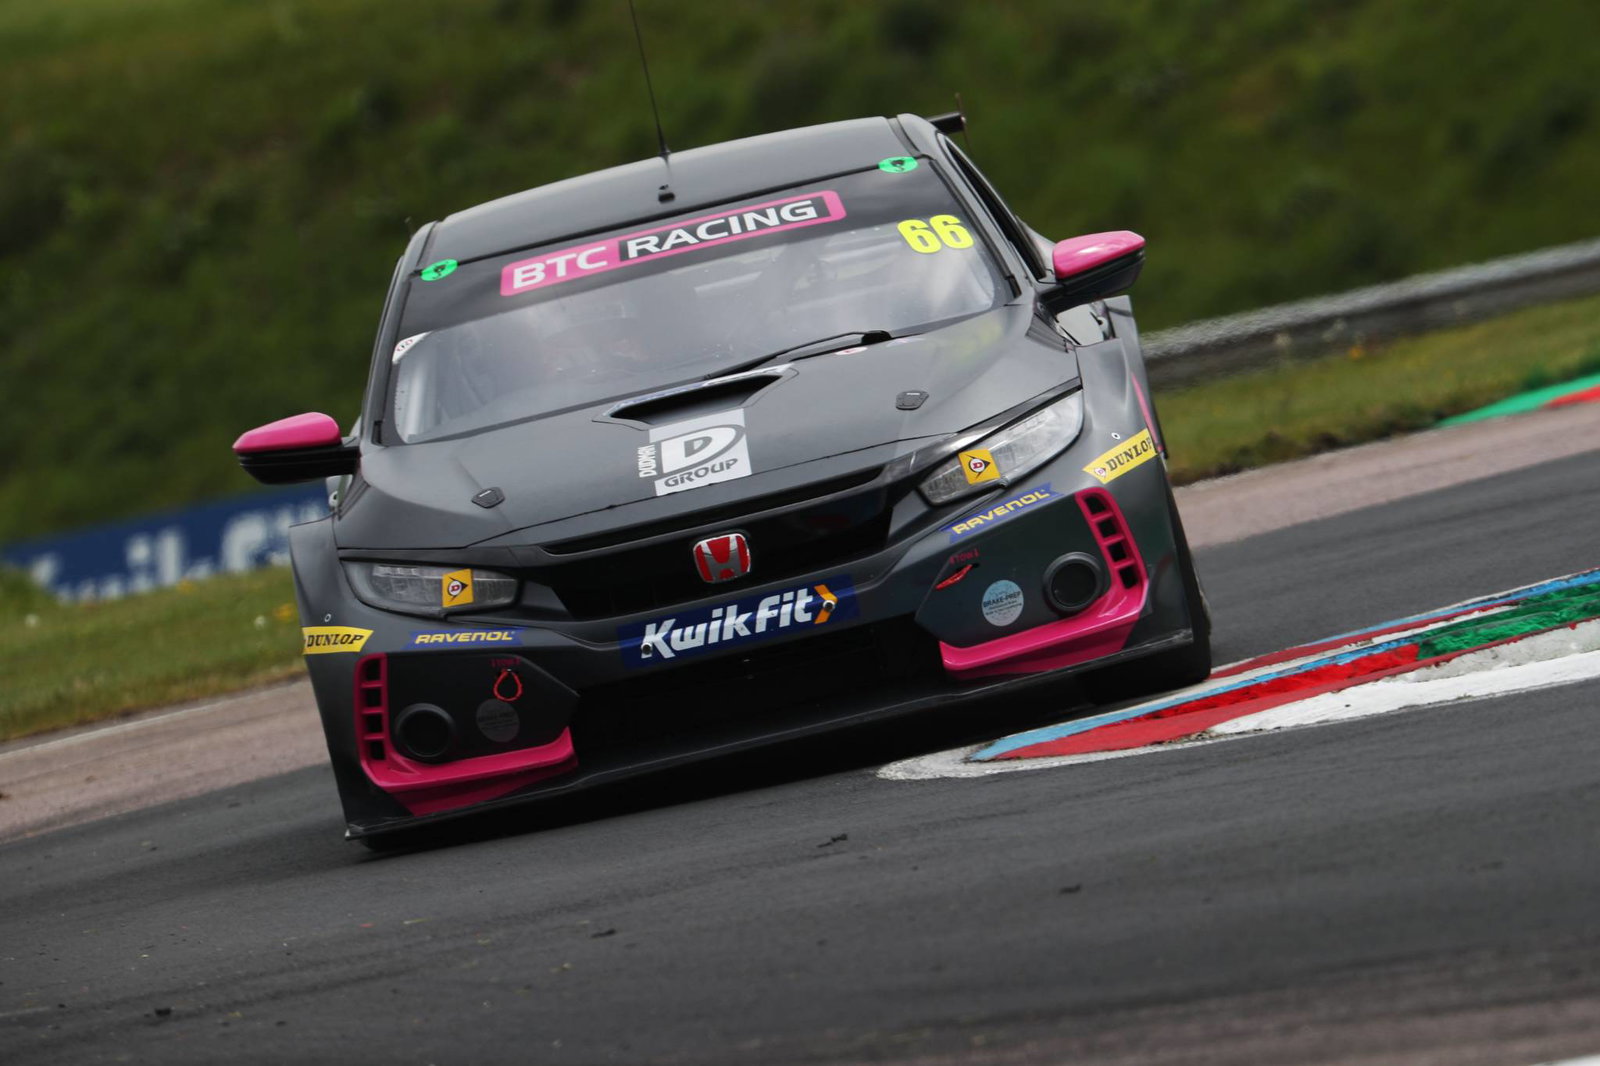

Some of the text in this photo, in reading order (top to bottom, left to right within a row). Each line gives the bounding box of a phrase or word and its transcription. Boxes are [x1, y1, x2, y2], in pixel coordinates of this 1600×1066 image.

[513, 199, 817, 289] BTC RACING
[897, 214, 974, 253] 66
[664, 458, 738, 487] GROUP
[952, 491, 1050, 534] RAVENOL
[306, 633, 364, 648] DUNLOP
[415, 631, 513, 645] RAVENOL
